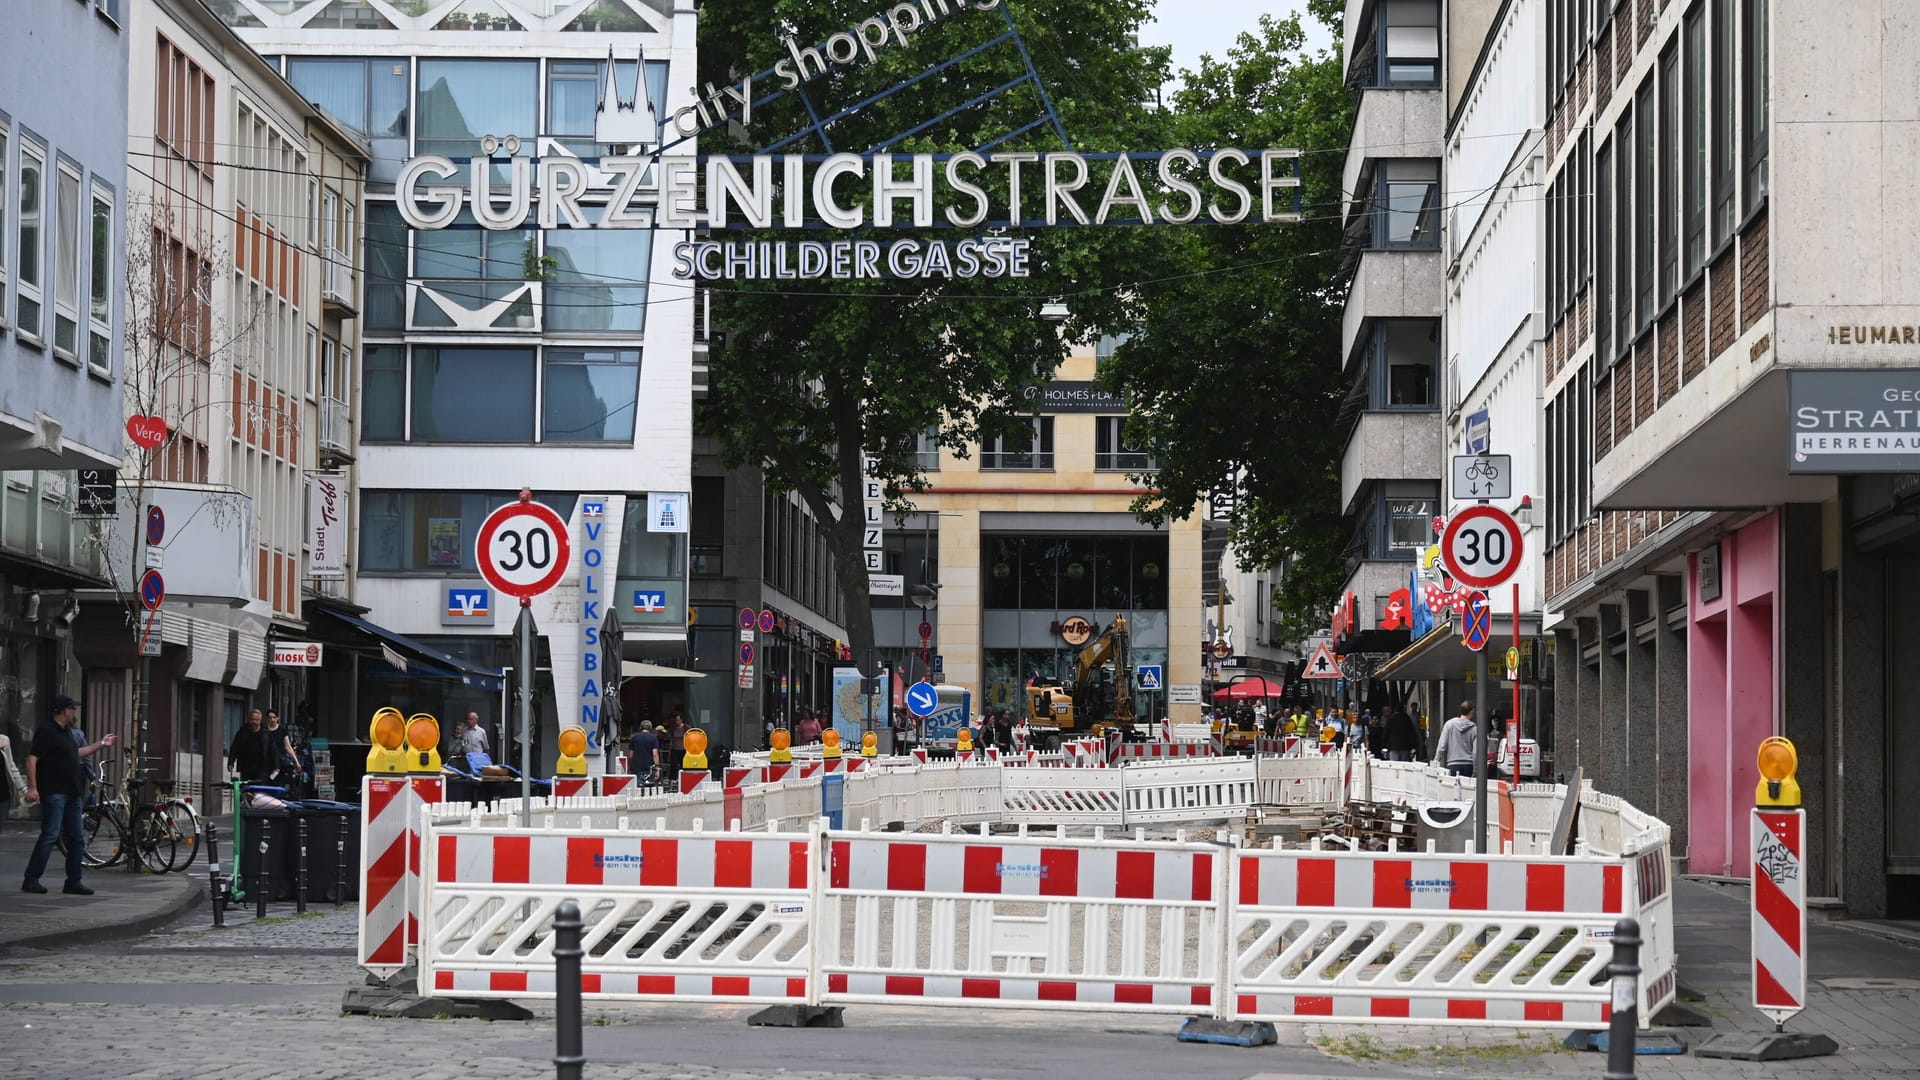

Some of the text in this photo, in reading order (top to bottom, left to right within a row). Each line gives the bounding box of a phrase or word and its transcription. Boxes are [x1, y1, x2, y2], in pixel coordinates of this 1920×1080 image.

[673, 0, 1000, 138] city shopp
[395, 134, 1300, 230] GÜRZENICHSTRASSE
[672, 240, 1030, 279] SCHILDERGASSE
[1829, 326, 1920, 345] HEUMAR
[1045, 390, 1089, 400] HOLMES
[135, 423, 162, 441] Vera
[1796, 407, 1920, 429] STRAT
[318, 479, 338, 527] Treff
[1393, 505, 1415, 514] WIR
[315, 527, 325, 561] Stadt
[498, 527, 551, 572] 30
[1459, 528, 1505, 566] 30
[581, 523, 602, 749] VOLKSBANK
[275, 653, 304, 663] KIOSK
